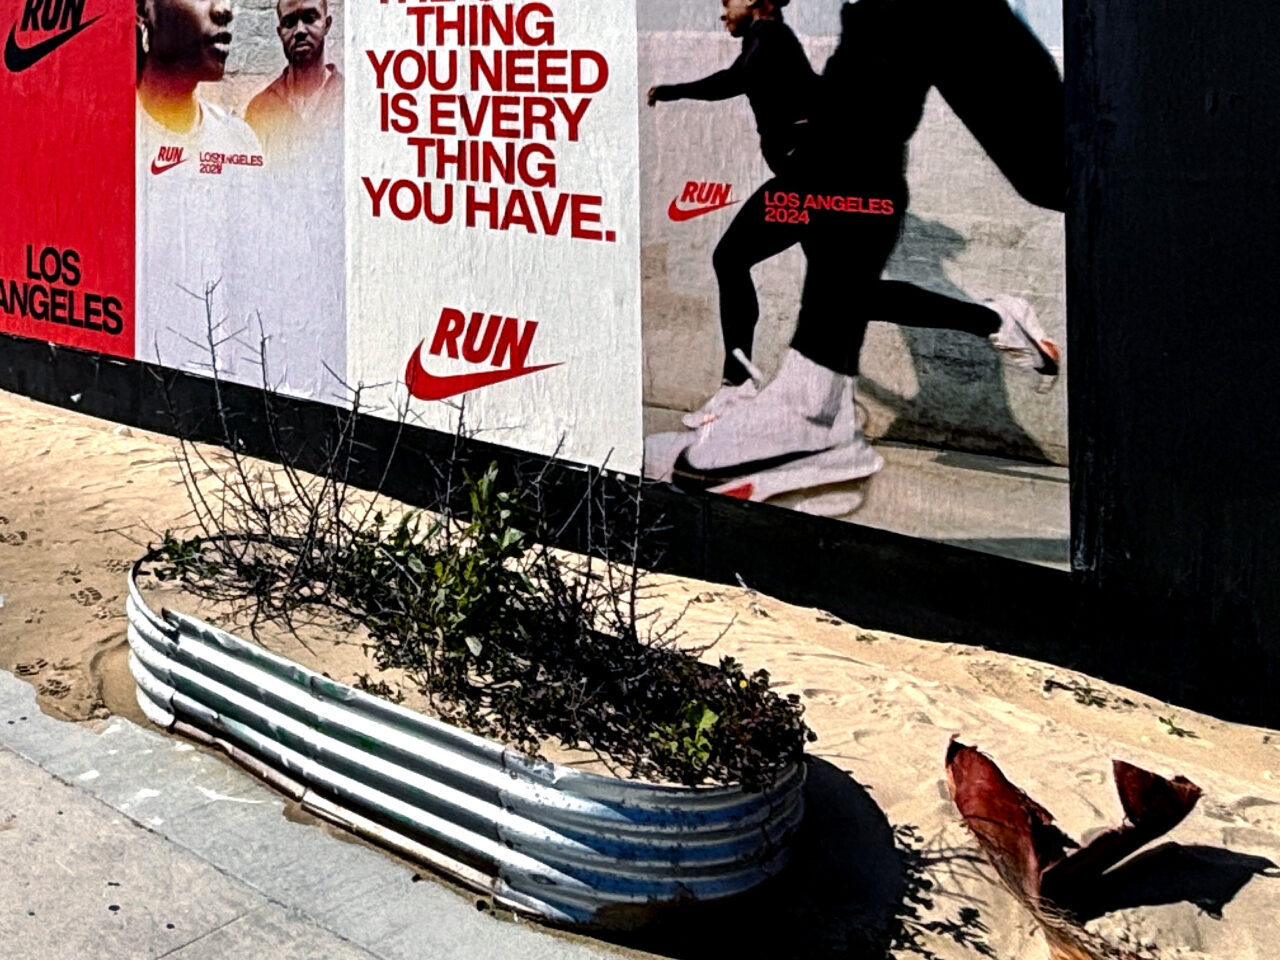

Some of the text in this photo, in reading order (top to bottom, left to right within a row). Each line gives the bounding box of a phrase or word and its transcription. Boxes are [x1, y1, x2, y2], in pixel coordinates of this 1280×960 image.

[407, 3, 554, 46] THING
[366, 49, 609, 94] YOU NEED
[380, 92, 591, 141] IS EVERY
[158, 146, 184, 162] RUN
[407, 138, 556, 188] THING
[361, 177, 616, 243] YOU HAVE.
[680, 181, 732, 204] RUN
[765, 191, 894, 215] LOS ANGELES
[765, 208, 810, 224] 2024
[27, 244, 81, 286] LOS
[429, 307, 538, 367] RUN
